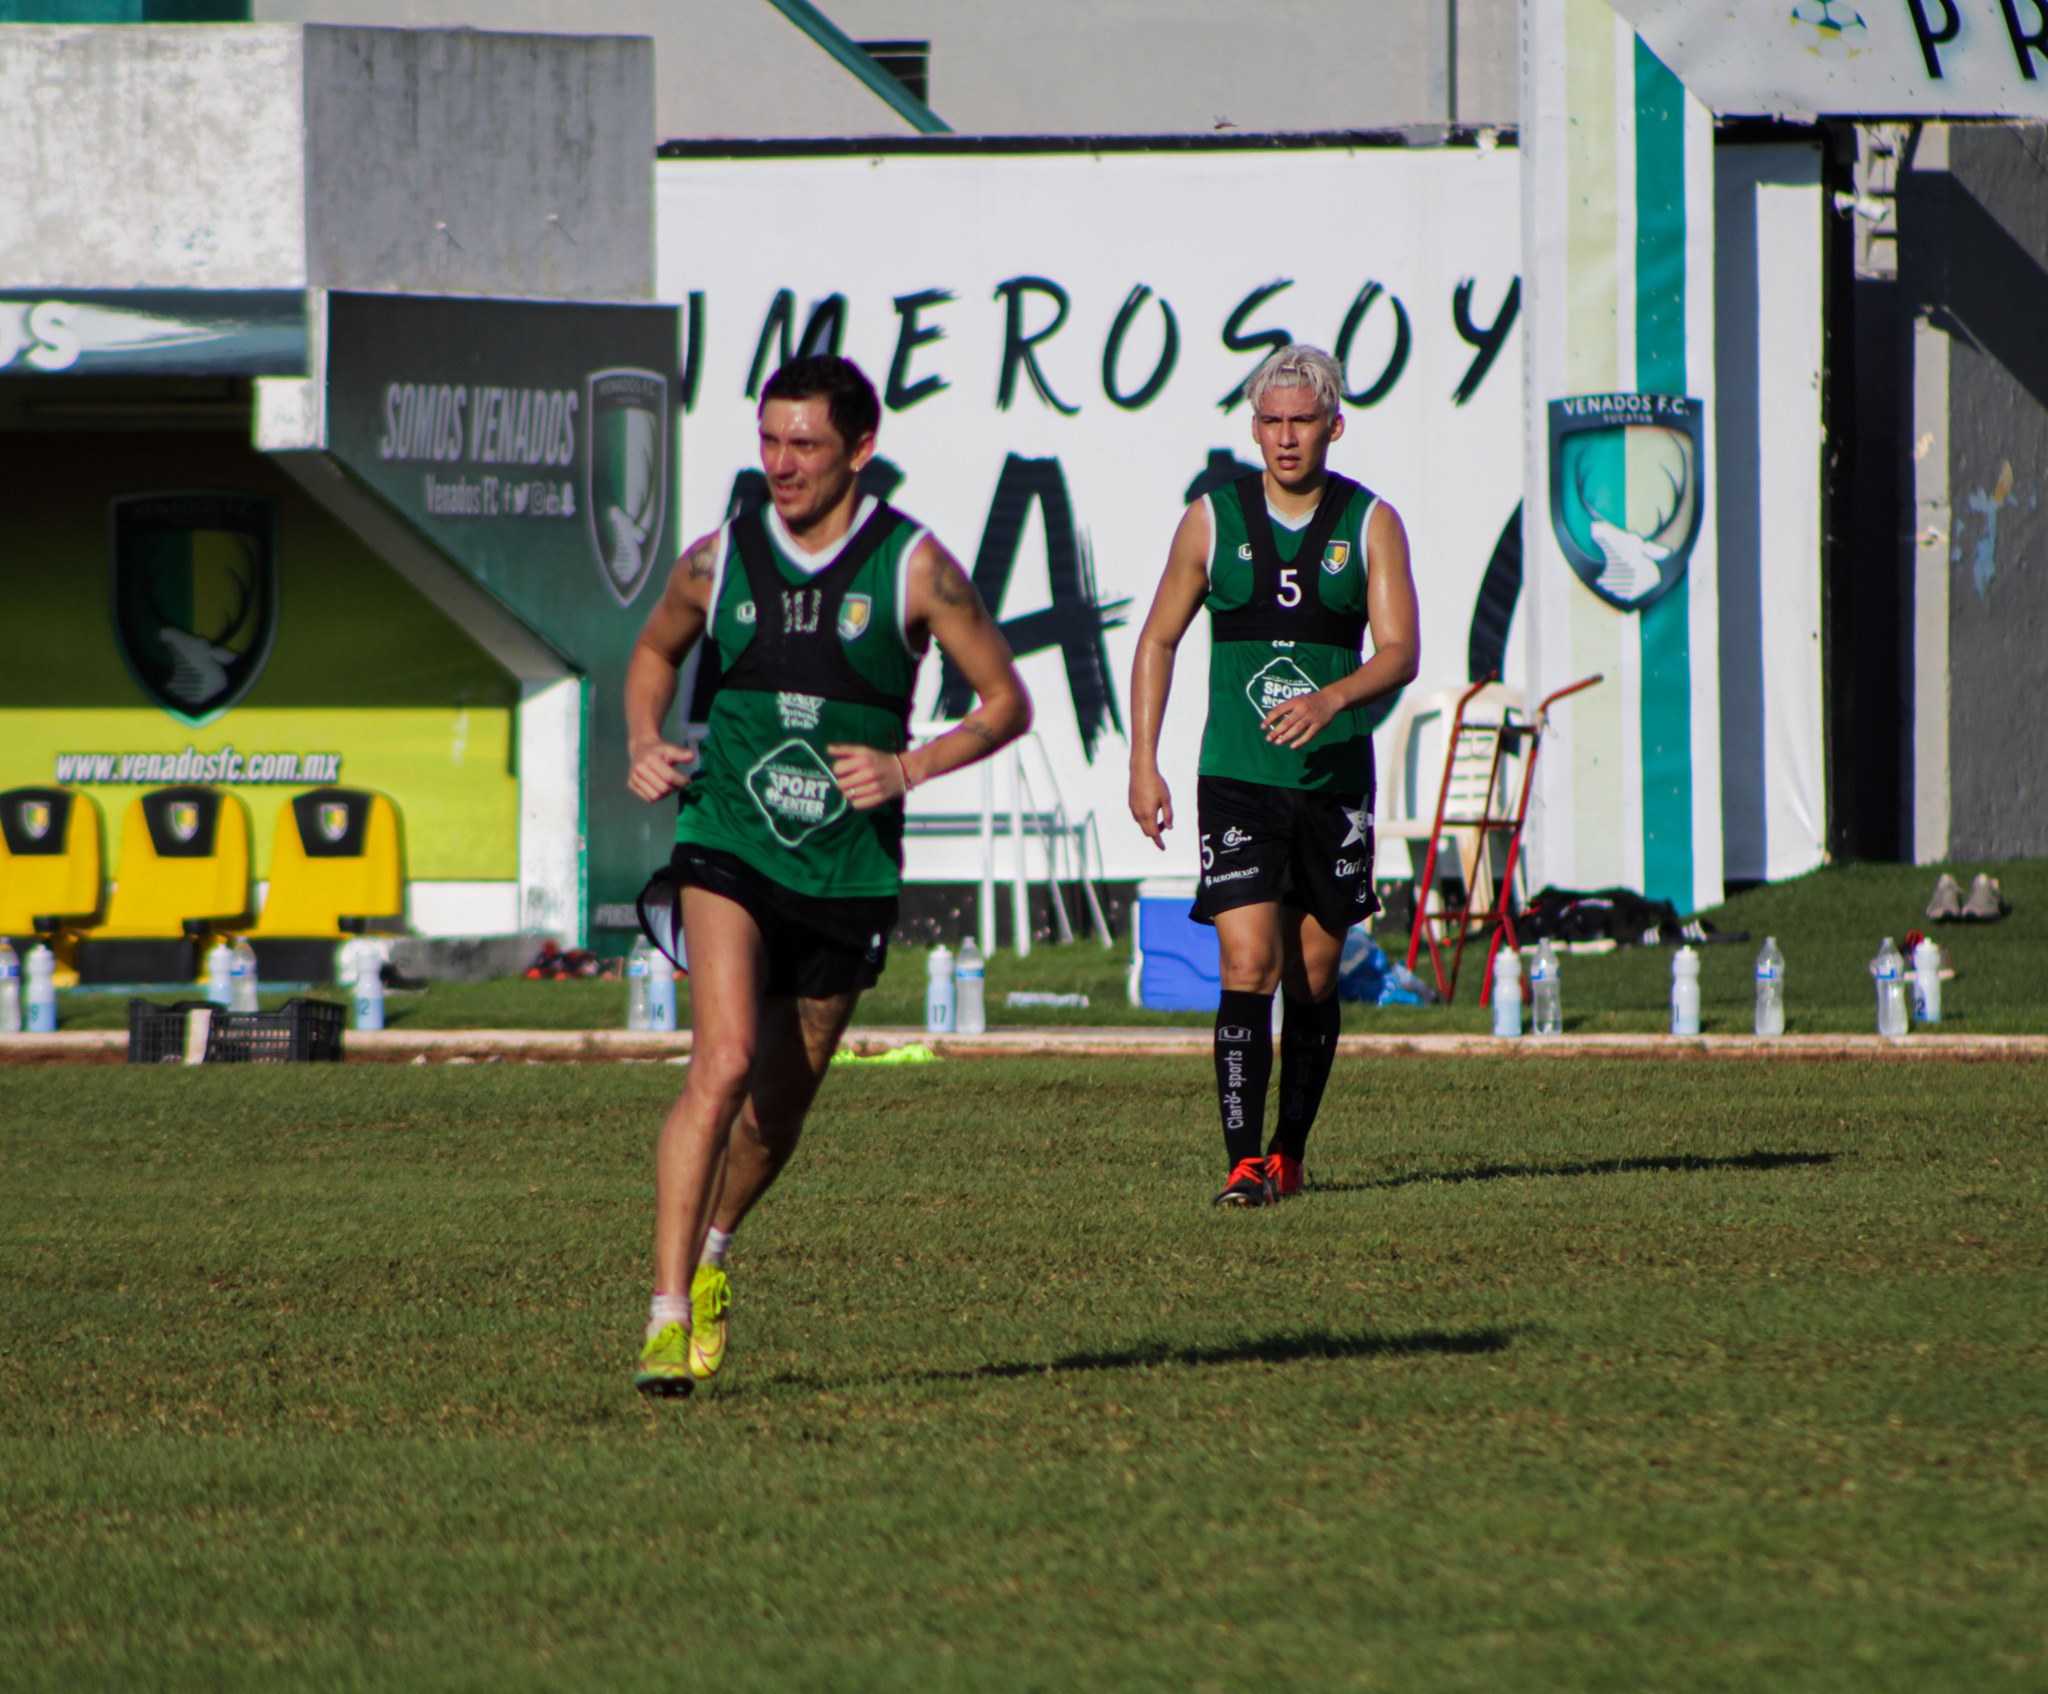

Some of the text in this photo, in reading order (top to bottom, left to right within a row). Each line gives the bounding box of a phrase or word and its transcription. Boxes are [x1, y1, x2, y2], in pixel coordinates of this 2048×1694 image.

[380, 382, 579, 467] SOMOS VENADOS
[1562, 395, 1651, 417] VENADOS
[424, 475, 499, 516] Venados FC
[1276, 568, 1302, 608] 5
[56, 745, 341, 782] www.venadosfc.com.mx
[767, 771, 831, 801] SPORT
[1201, 834, 1214, 870] 5
[1224, 1049, 1248, 1088] sports
